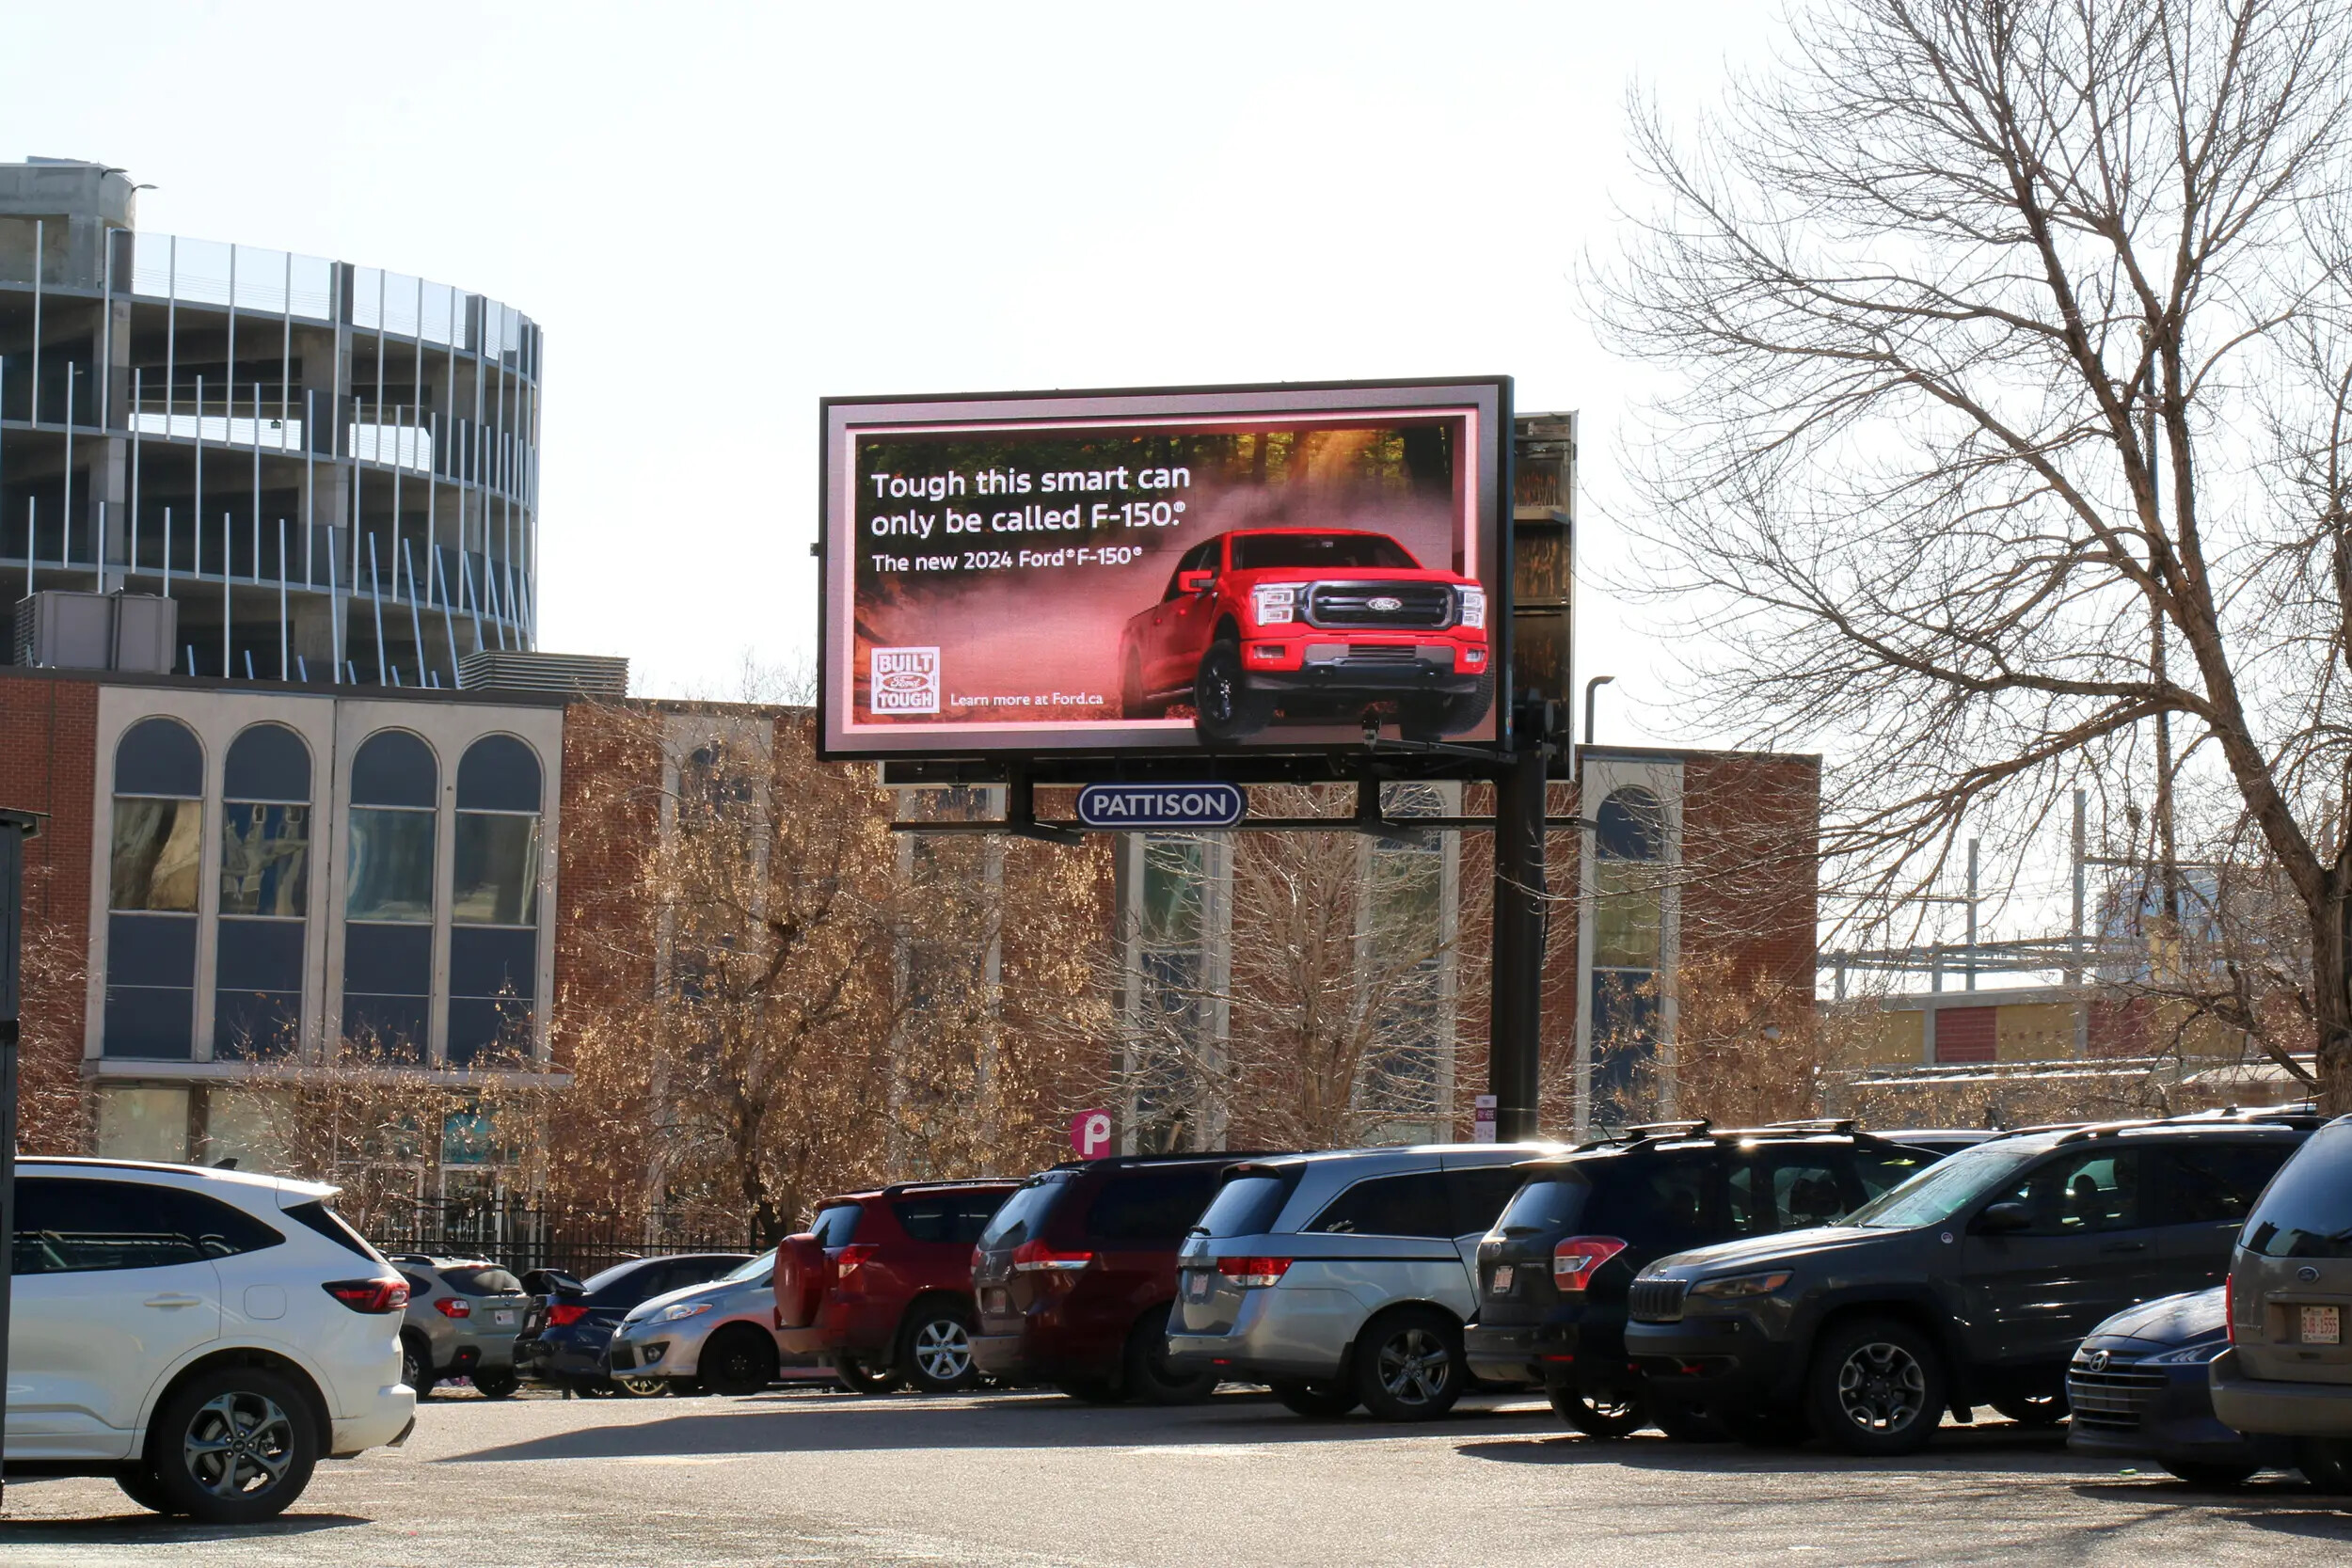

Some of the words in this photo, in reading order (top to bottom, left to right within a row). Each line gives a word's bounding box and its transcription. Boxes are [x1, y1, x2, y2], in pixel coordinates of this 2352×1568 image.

[871, 470, 965, 501] Tough
[977, 467, 1032, 495] this
[1041, 467, 1129, 493] smart
[1137, 467, 1190, 489] can
[871, 509, 936, 539] only
[946, 508, 981, 533] be
[992, 504, 1081, 531] called
[871, 554, 909, 572] The
[915, 553, 958, 571] new
[963, 550, 1012, 569] 2024
[879, 653, 933, 673] BUILT
[878, 692, 933, 708] TOUGH
[950, 693, 989, 706] Learn
[993, 694, 1030, 706] more
[1034, 694, 1049, 705] at
[1053, 692, 1104, 705] Ford.ca
[1093, 793, 1227, 816] PATTISON
